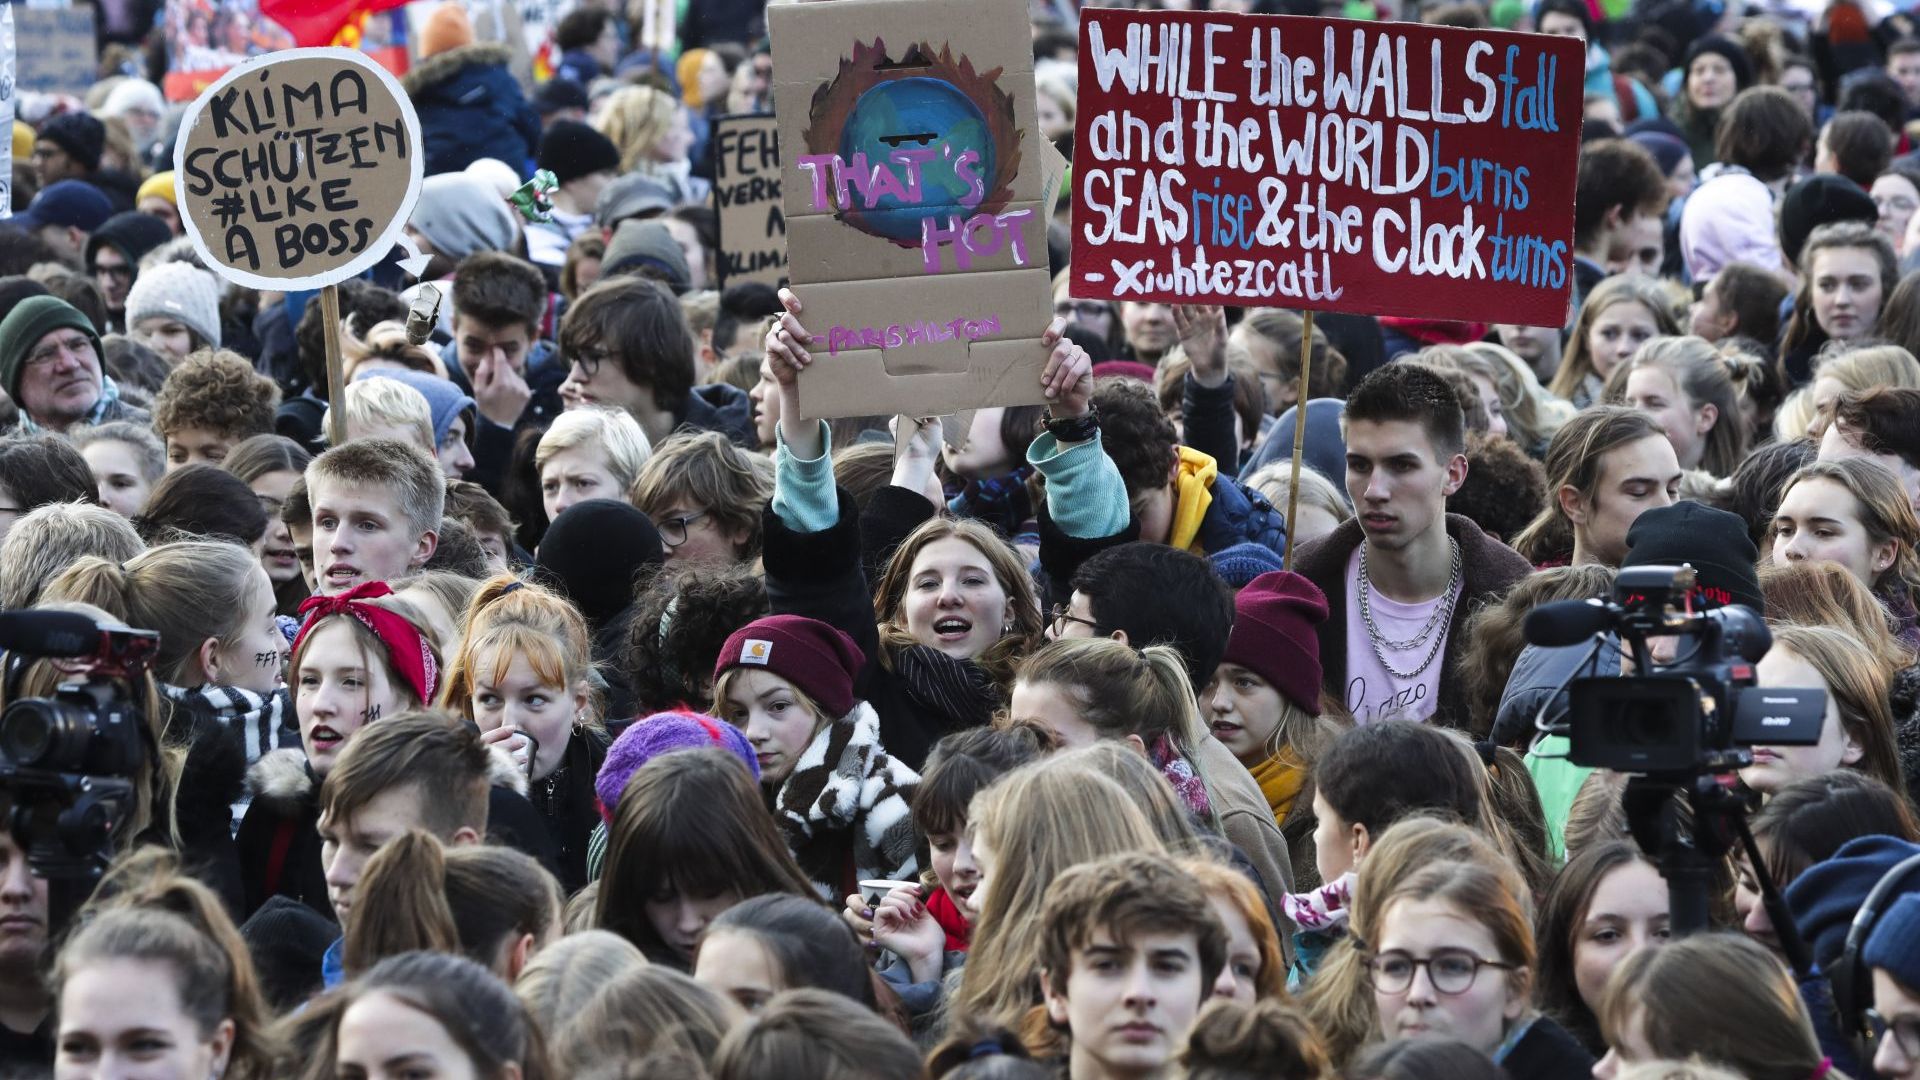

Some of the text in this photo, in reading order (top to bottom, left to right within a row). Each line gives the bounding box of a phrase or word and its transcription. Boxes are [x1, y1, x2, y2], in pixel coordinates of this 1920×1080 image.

[1088, 20, 1560, 133] WHILE the WALLS fall
[184, 117, 407, 197] SCHÜTZEN
[797, 143, 986, 211] THAT'S
[1089, 97, 1530, 211] and the WORLD burns
[225, 218, 374, 271] A BOSS
[921, 208, 1035, 274] HOT
[1083, 167, 1189, 245] SEAS
[1192, 177, 1257, 250] rise
[1255, 176, 1295, 248] &
[1293, 181, 1363, 256] the
[1488, 213, 1567, 289] turns
[905, 313, 1002, 345] HILTON
